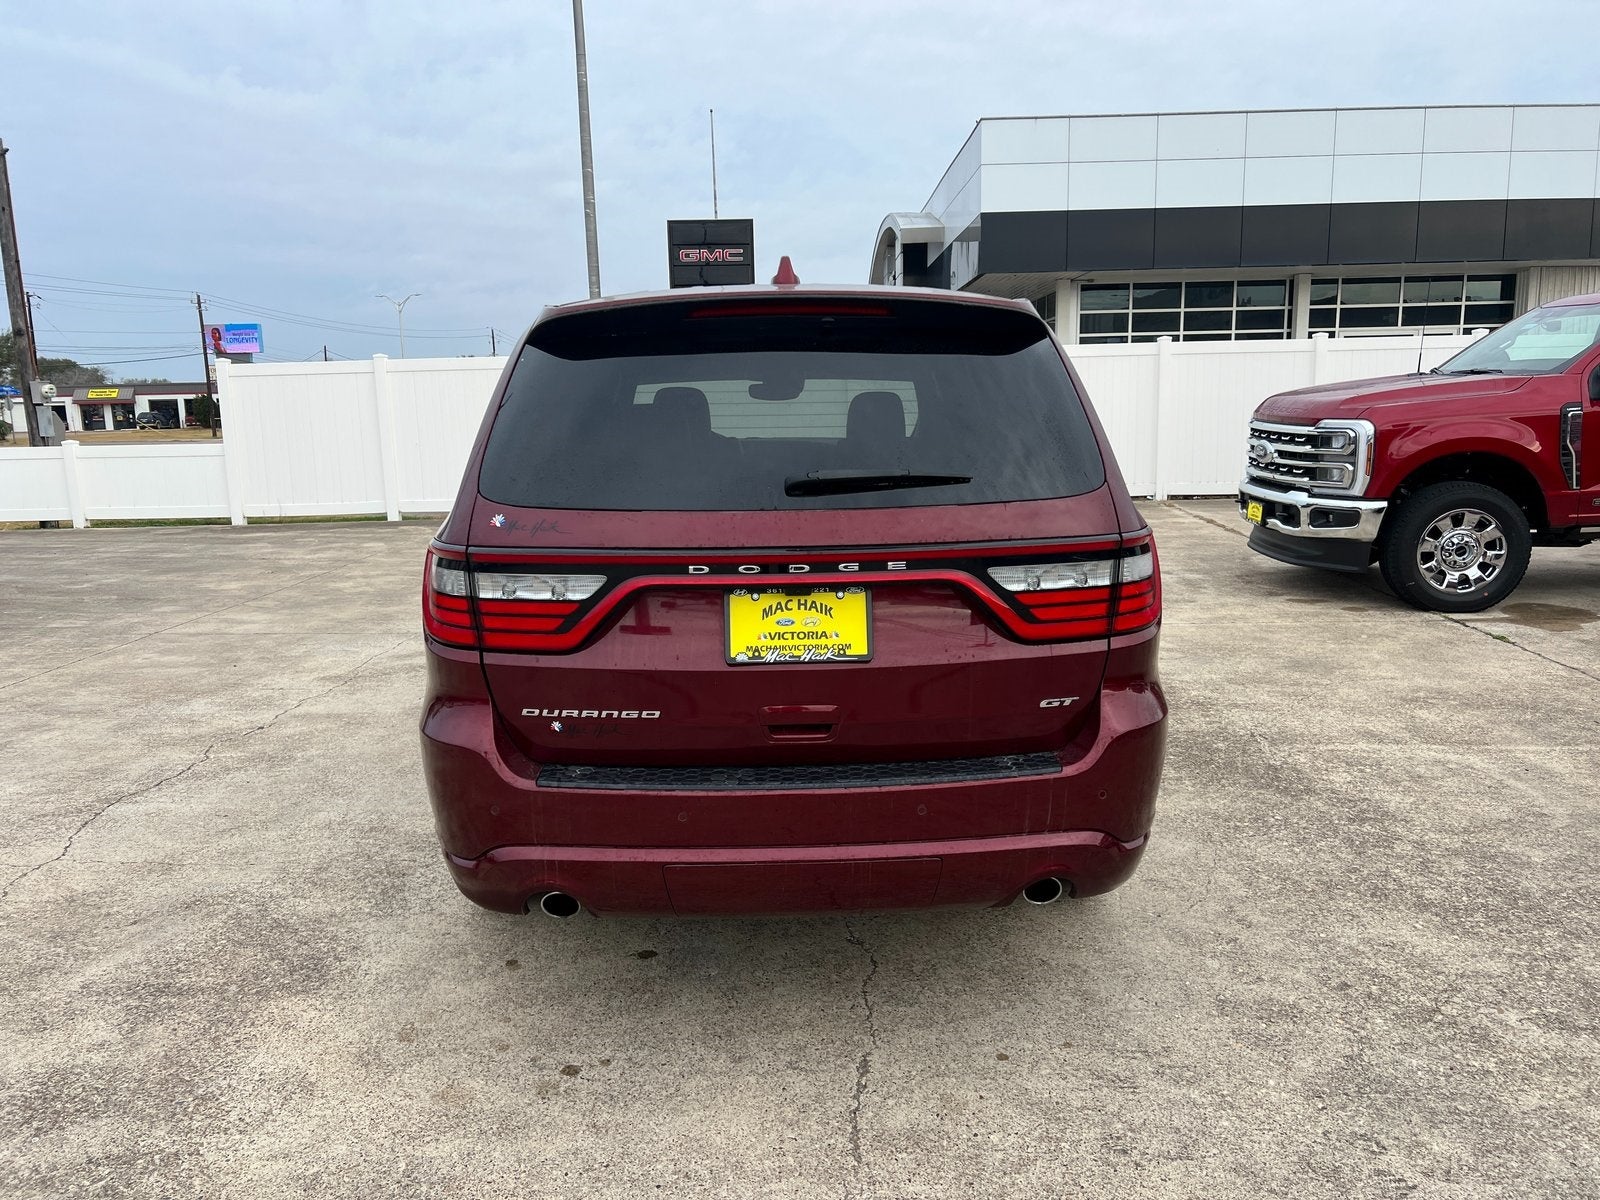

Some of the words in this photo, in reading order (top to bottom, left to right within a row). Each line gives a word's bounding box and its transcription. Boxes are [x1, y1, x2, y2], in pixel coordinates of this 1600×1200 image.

[679, 248, 744, 262] GMC
[688, 561, 907, 574] DODGE
[761, 598, 794, 620] MAC
[797, 598, 834, 619] HAIK
[767, 631, 829, 641] VICTORIA
[763, 648, 797, 662] Mac
[800, 647, 844, 662] Haik
[1039, 696, 1080, 708] GT
[521, 708, 661, 719] DURANGO
